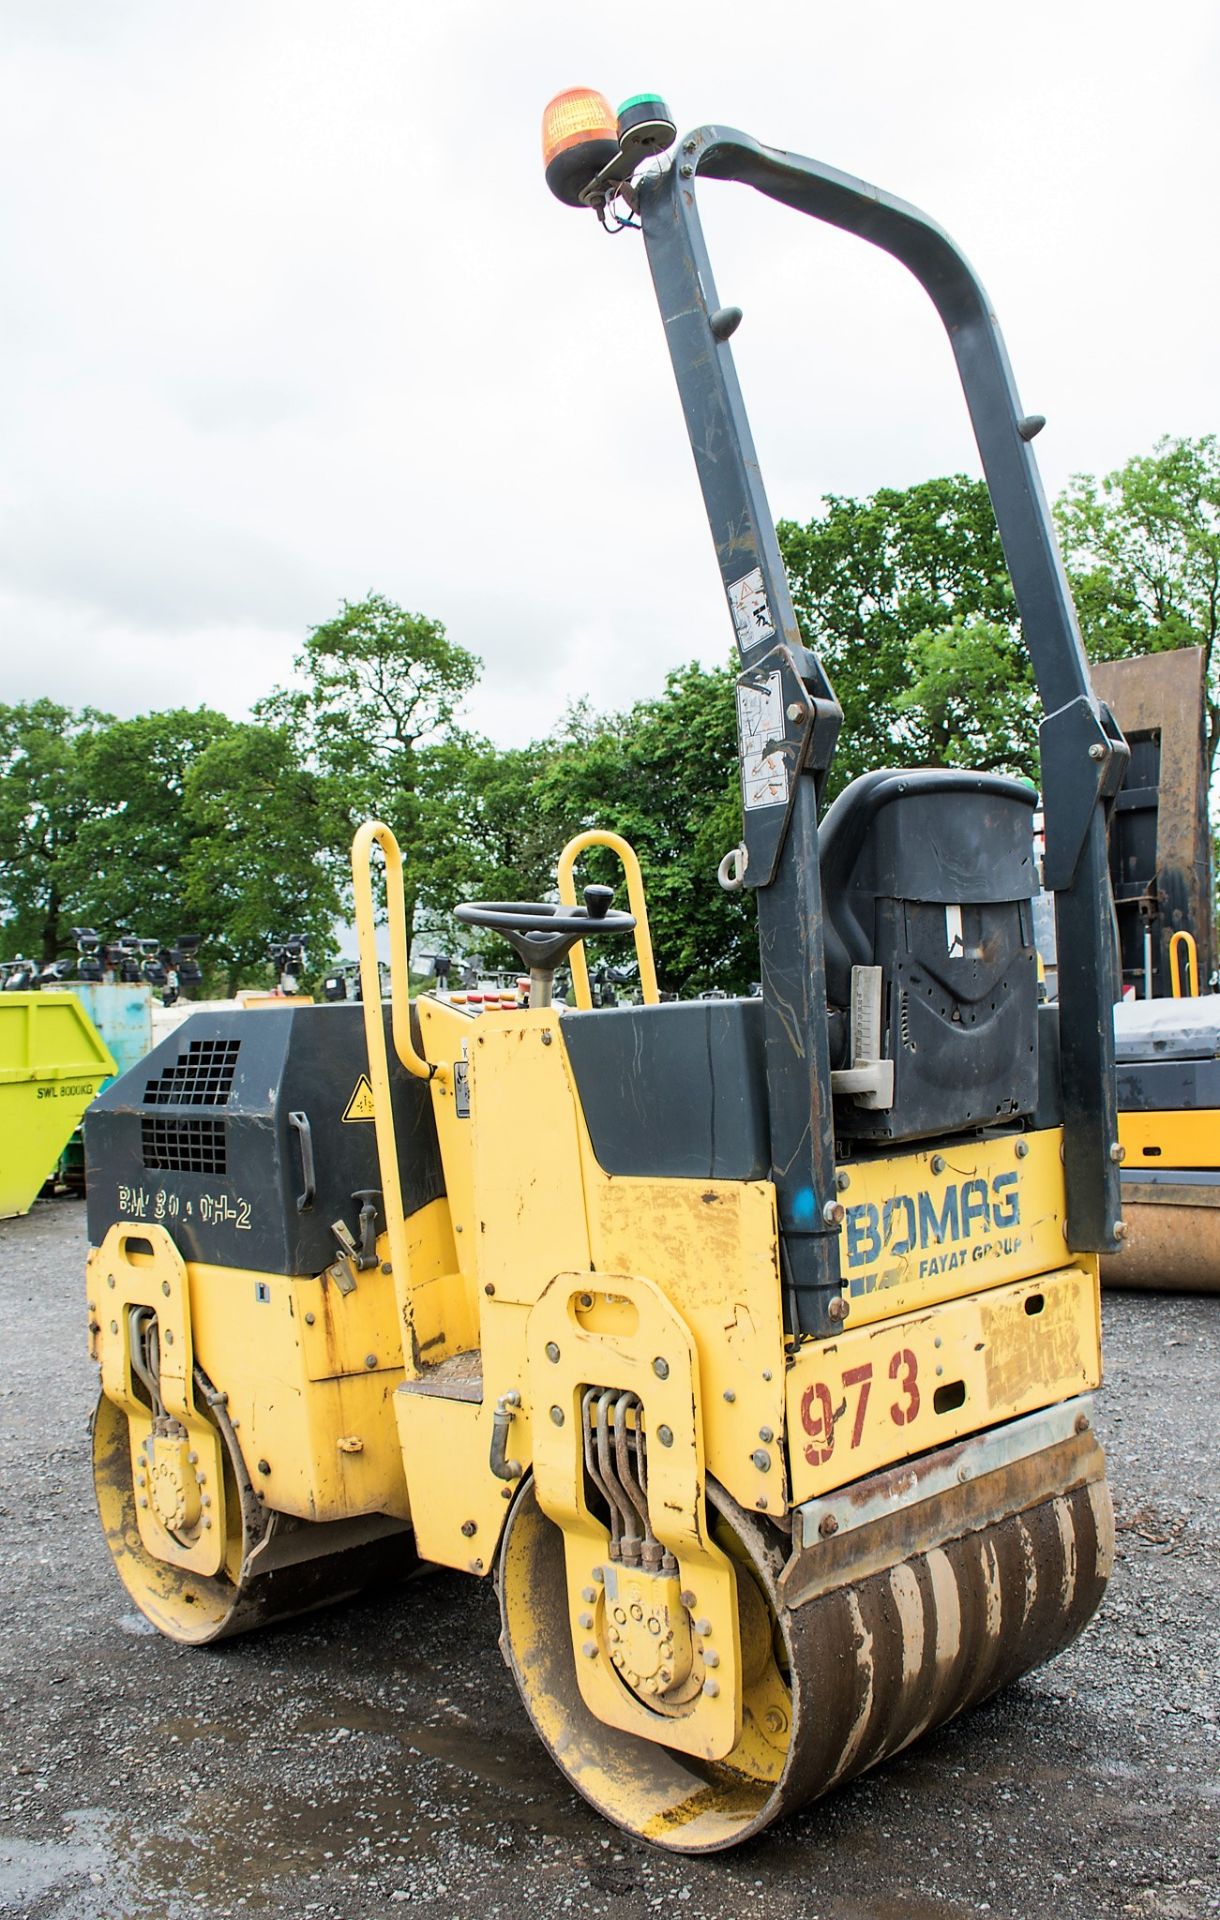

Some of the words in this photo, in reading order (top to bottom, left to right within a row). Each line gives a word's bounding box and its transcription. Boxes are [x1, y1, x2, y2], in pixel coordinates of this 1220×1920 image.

[37, 1087, 58, 1099] SWL
[846, 1171, 1020, 1268] BOMAG
[919, 1249, 967, 1279] FAYAT
[800, 1348, 921, 1467] 973
